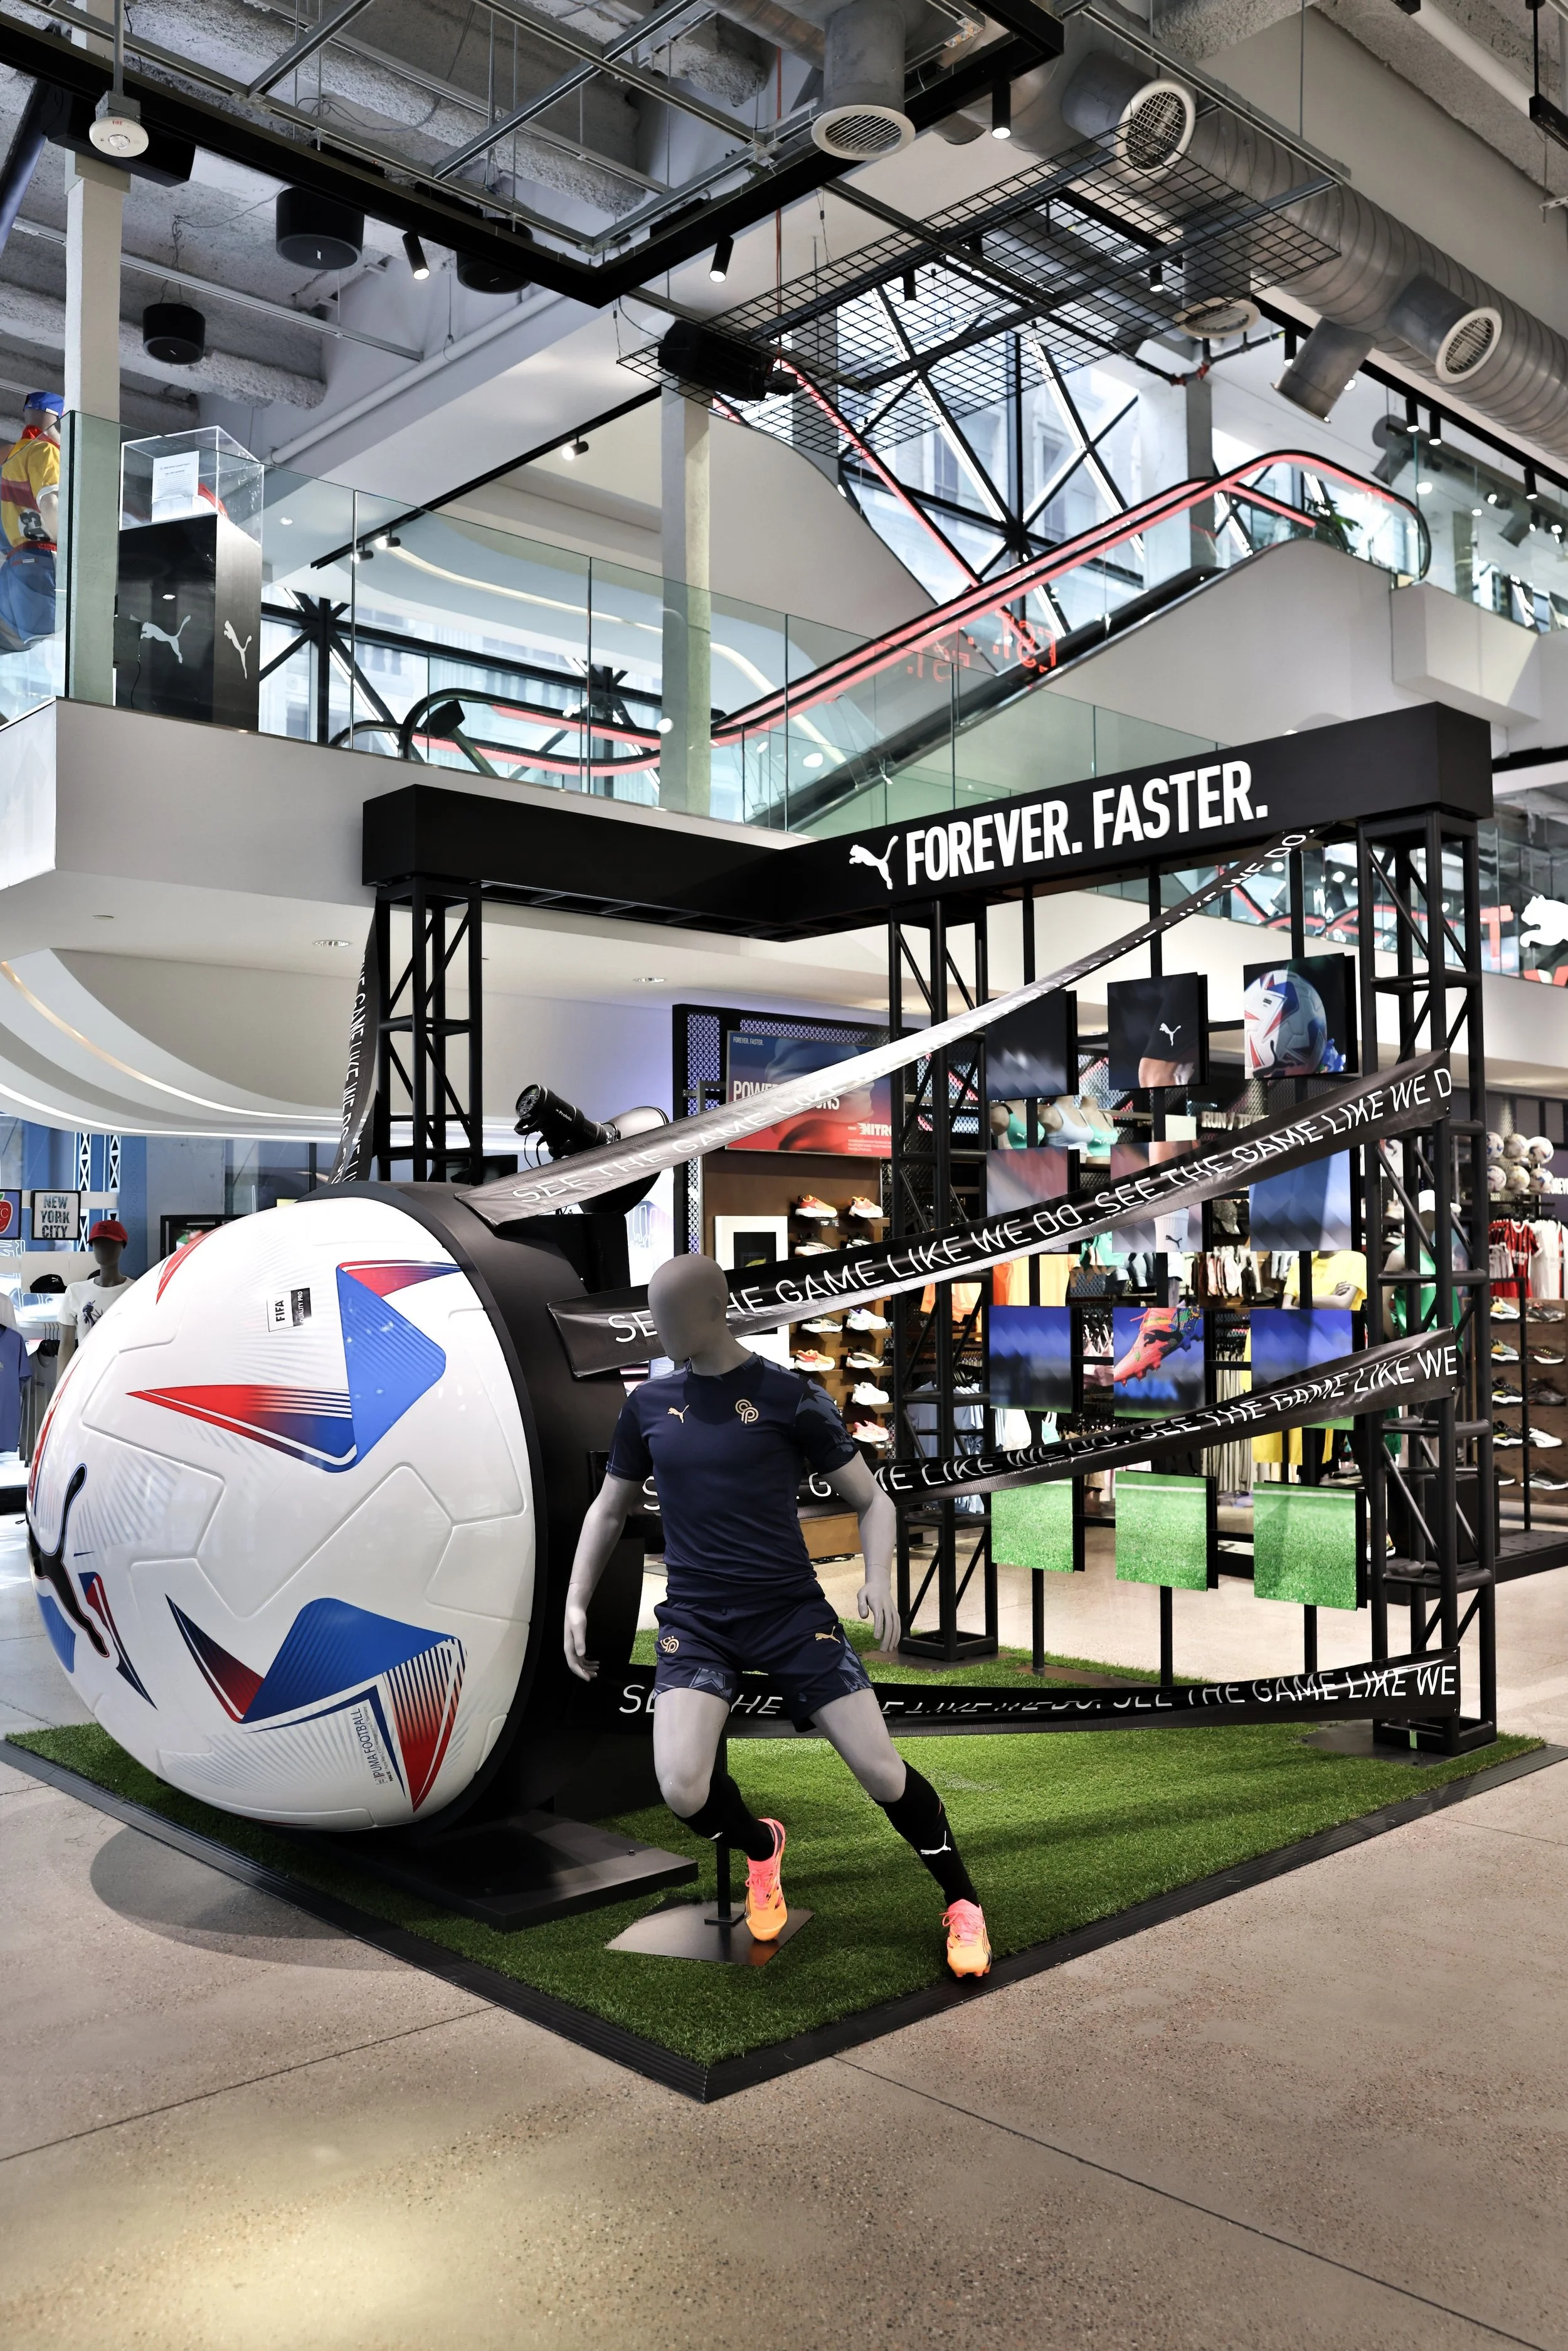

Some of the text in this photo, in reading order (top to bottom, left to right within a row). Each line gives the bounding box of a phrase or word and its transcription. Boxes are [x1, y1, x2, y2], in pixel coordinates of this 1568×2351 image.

[906, 760, 1268, 886] FOREVER. FASTER.
[733, 1036, 764, 1046] FOREVER. FASTER.
[559, 1110, 572, 1122] Profoto
[1201, 1111, 1227, 1128] RUN
[512, 1174, 590, 1203] SEE
[588, 1149, 670, 1177] THE
[672, 1112, 775, 1154] GAME
[43, 1195, 68, 1209] NEW
[607, 1310, 658, 1343] SE
[725, 1287, 773, 1319] HE
[775, 1259, 884, 1304] GAME
[887, 1235, 972, 1278] LIKE
[971, 1219, 1032, 1253] WE
[1094, 1177, 1165, 1214] SEE
[1160, 1154, 1234, 1187] THE
[1232, 1120, 1324, 1164] GAME
[1321, 1090, 1384, 1135] LIKE
[1389, 1075, 1431, 1112] WE
[41, 1210, 70, 1224] YORK
[41, 1225, 68, 1238] CITY
[275, 1300, 285, 1322] FIFA
[921, 1456, 1003, 1486] LIKE
[1130, 1416, 1201, 1440] SEE
[1196, 1400, 1266, 1427] THE
[1270, 1372, 1349, 1412] GAME
[1353, 1354, 1415, 1393] LIKE
[1416, 1345, 1458, 1379] WE
[731, 1696, 783, 1715] HE
[1252, 1672, 1338, 1702] GAME
[1345, 1669, 1408, 1699] LIKE
[1416, 1665, 1457, 1696] WE
[350, 1707, 375, 1754] FOOTBALL
[366, 1753, 384, 1777] PUMA
